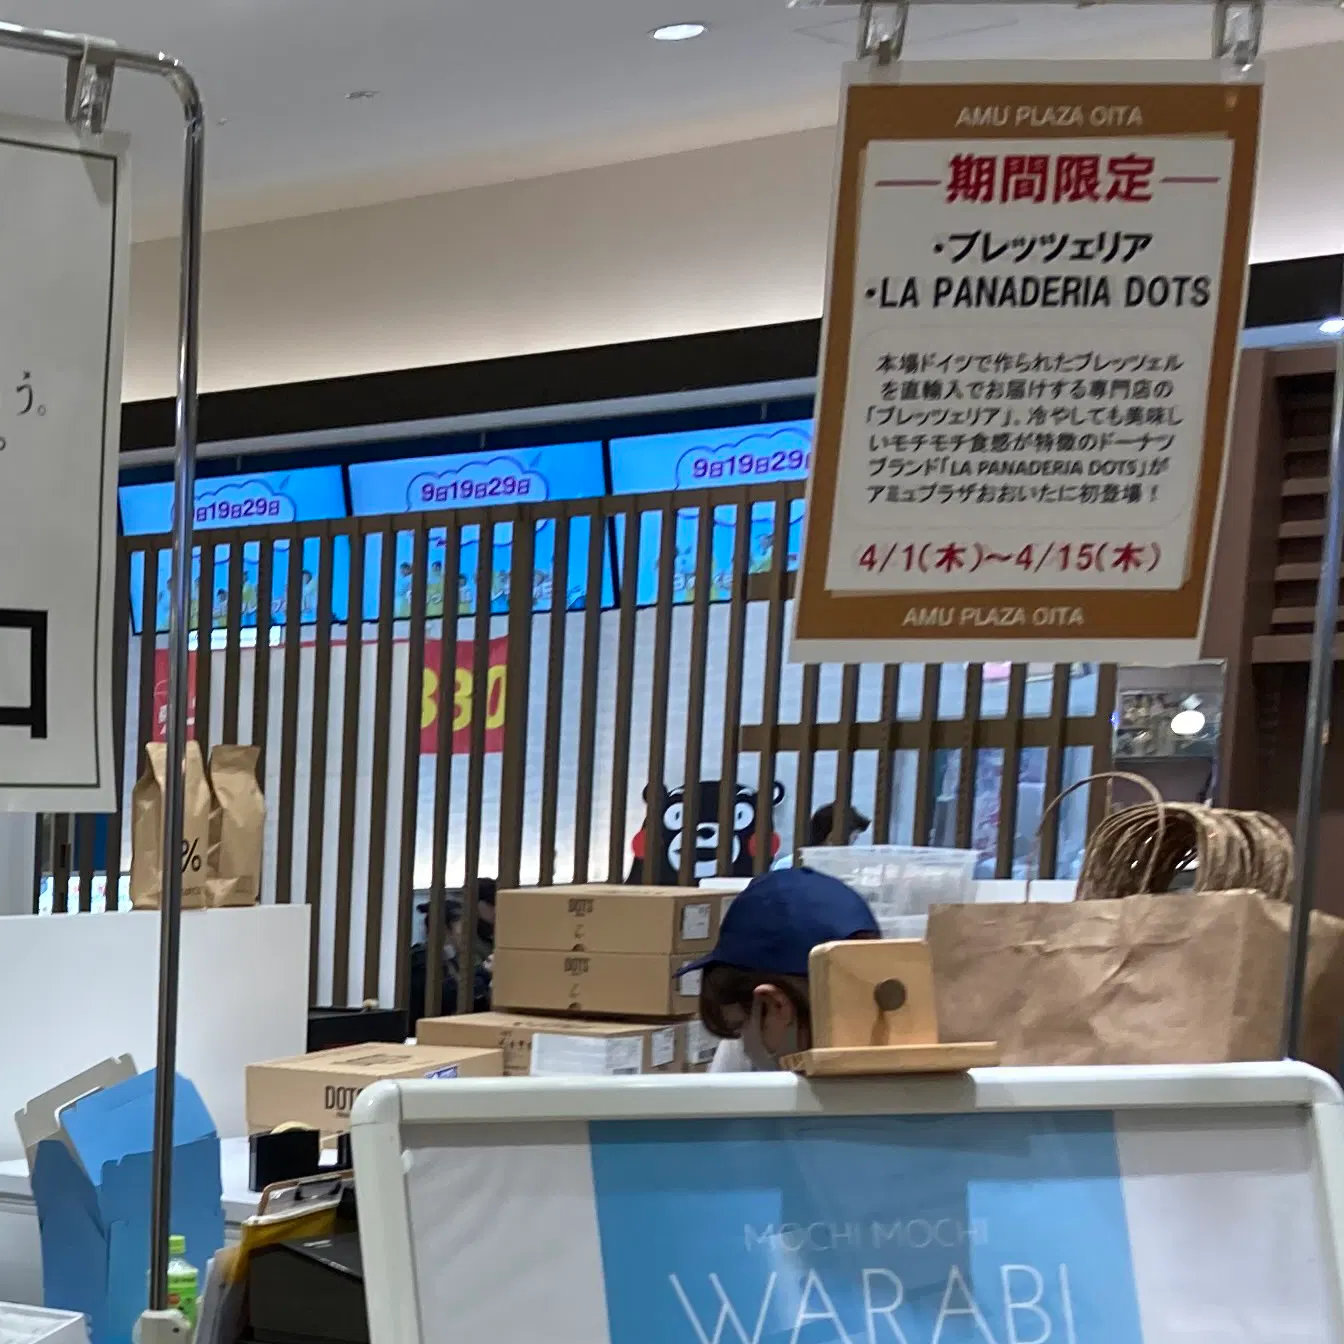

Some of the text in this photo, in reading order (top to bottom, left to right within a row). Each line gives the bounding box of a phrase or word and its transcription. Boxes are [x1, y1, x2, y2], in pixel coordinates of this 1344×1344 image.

[955, 105, 1144, 128] AMU PLAZA OITA
[944, 152, 1156, 205] 期間限定
[932, 275, 1111, 309] PANADERIA
[1124, 275, 1212, 308] DOTS
[901, 607, 1085, 627] AMU PLAZA OITA
[744, 1217, 989, 1251] MOCHI MOCHI
